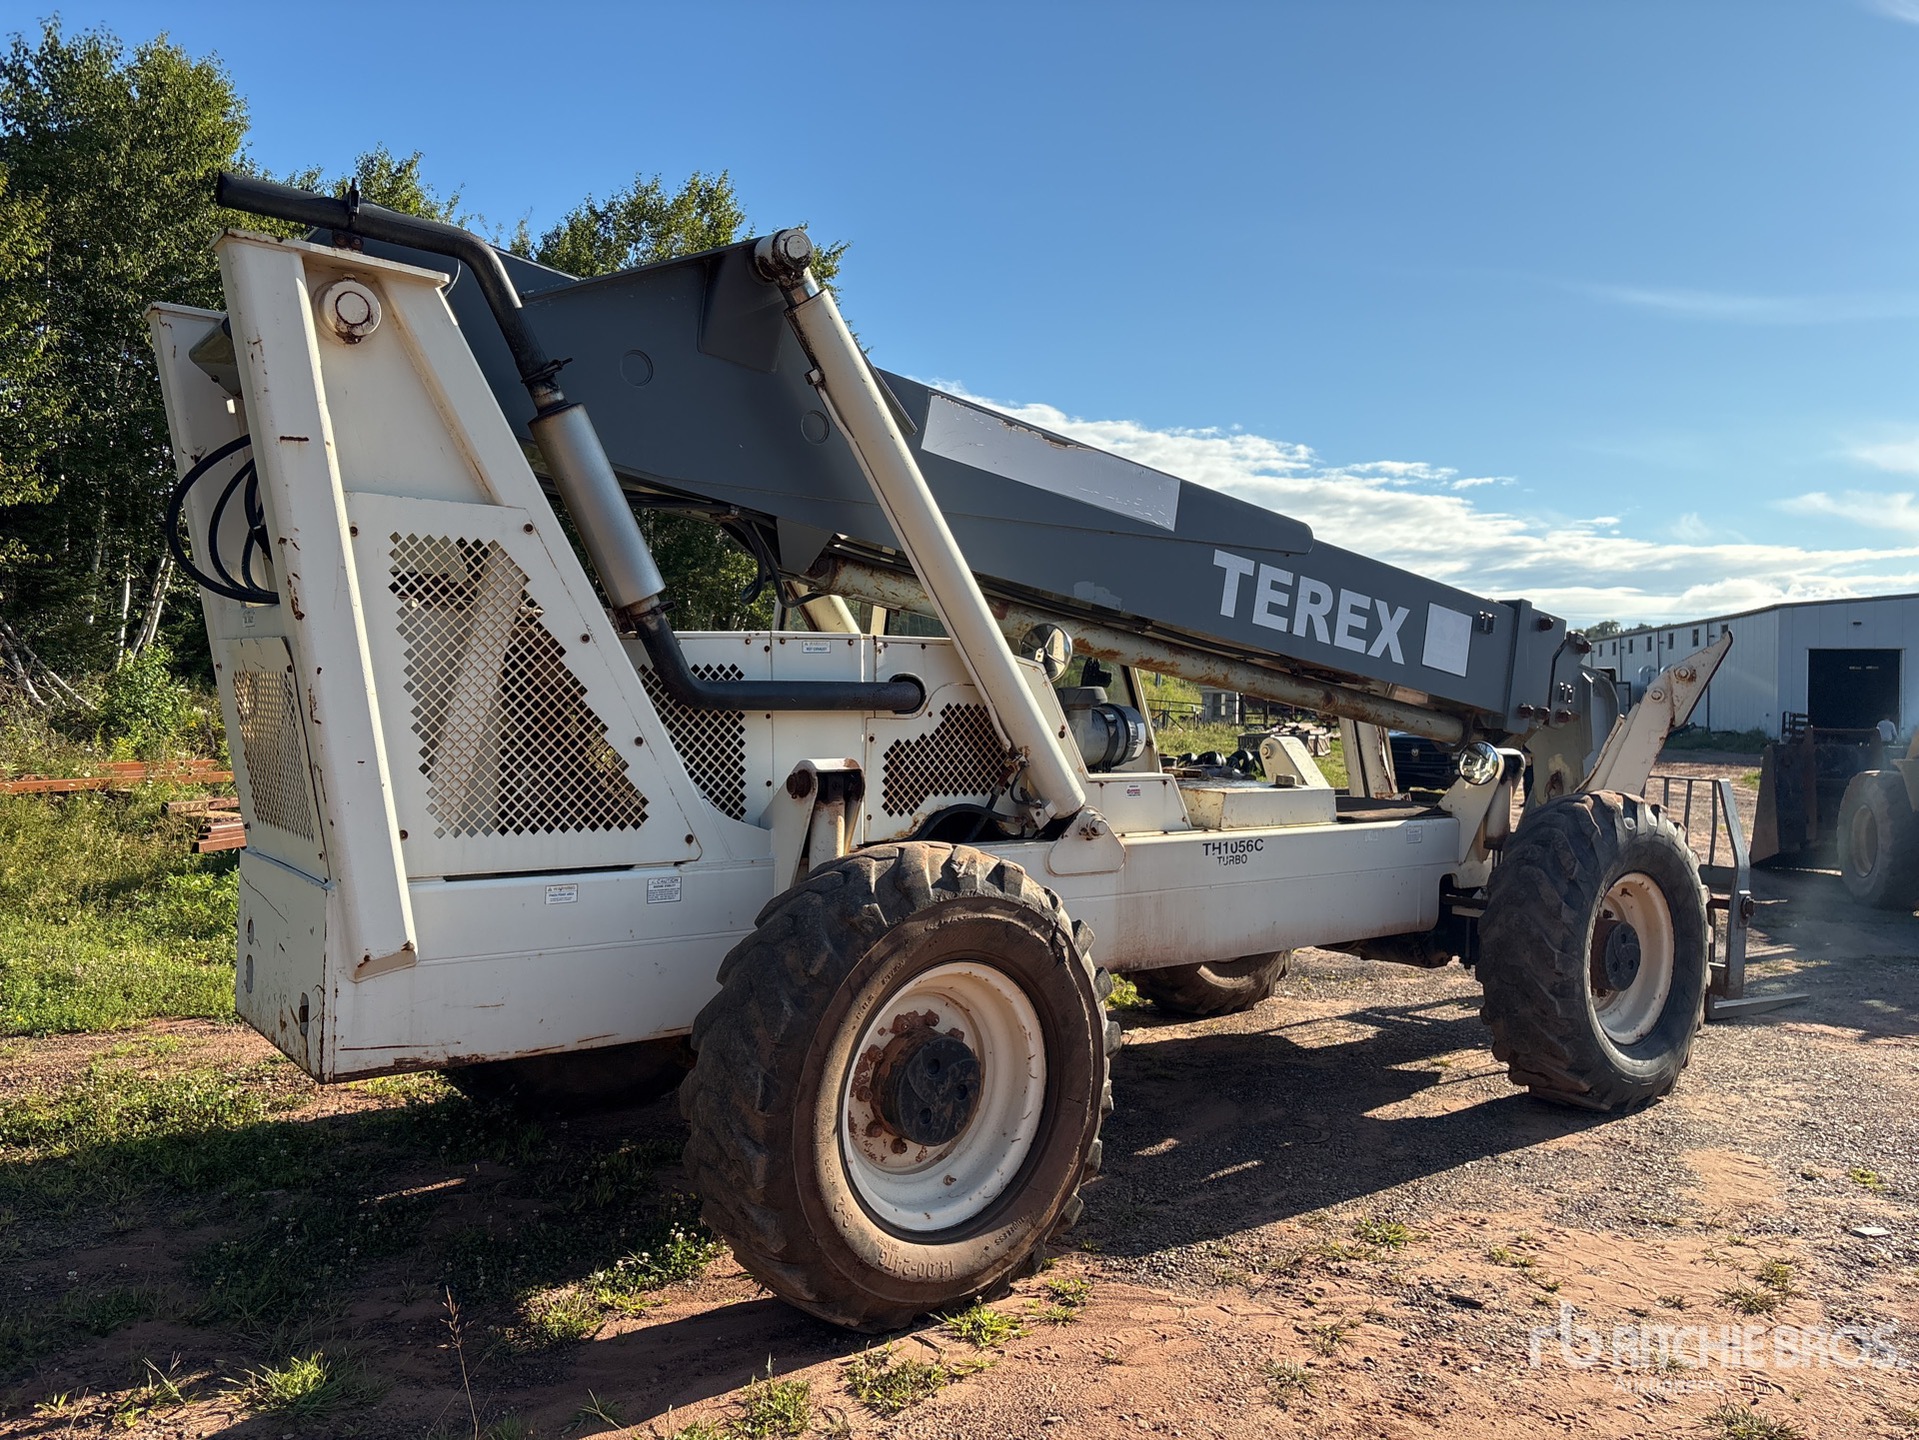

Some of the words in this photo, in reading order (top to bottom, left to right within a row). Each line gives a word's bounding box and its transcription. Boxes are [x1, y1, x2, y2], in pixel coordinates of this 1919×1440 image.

[1213, 549, 1410, 665] TEREX
[1202, 838, 1264, 856] TH1056C
[1217, 854, 1248, 866] TURBO
